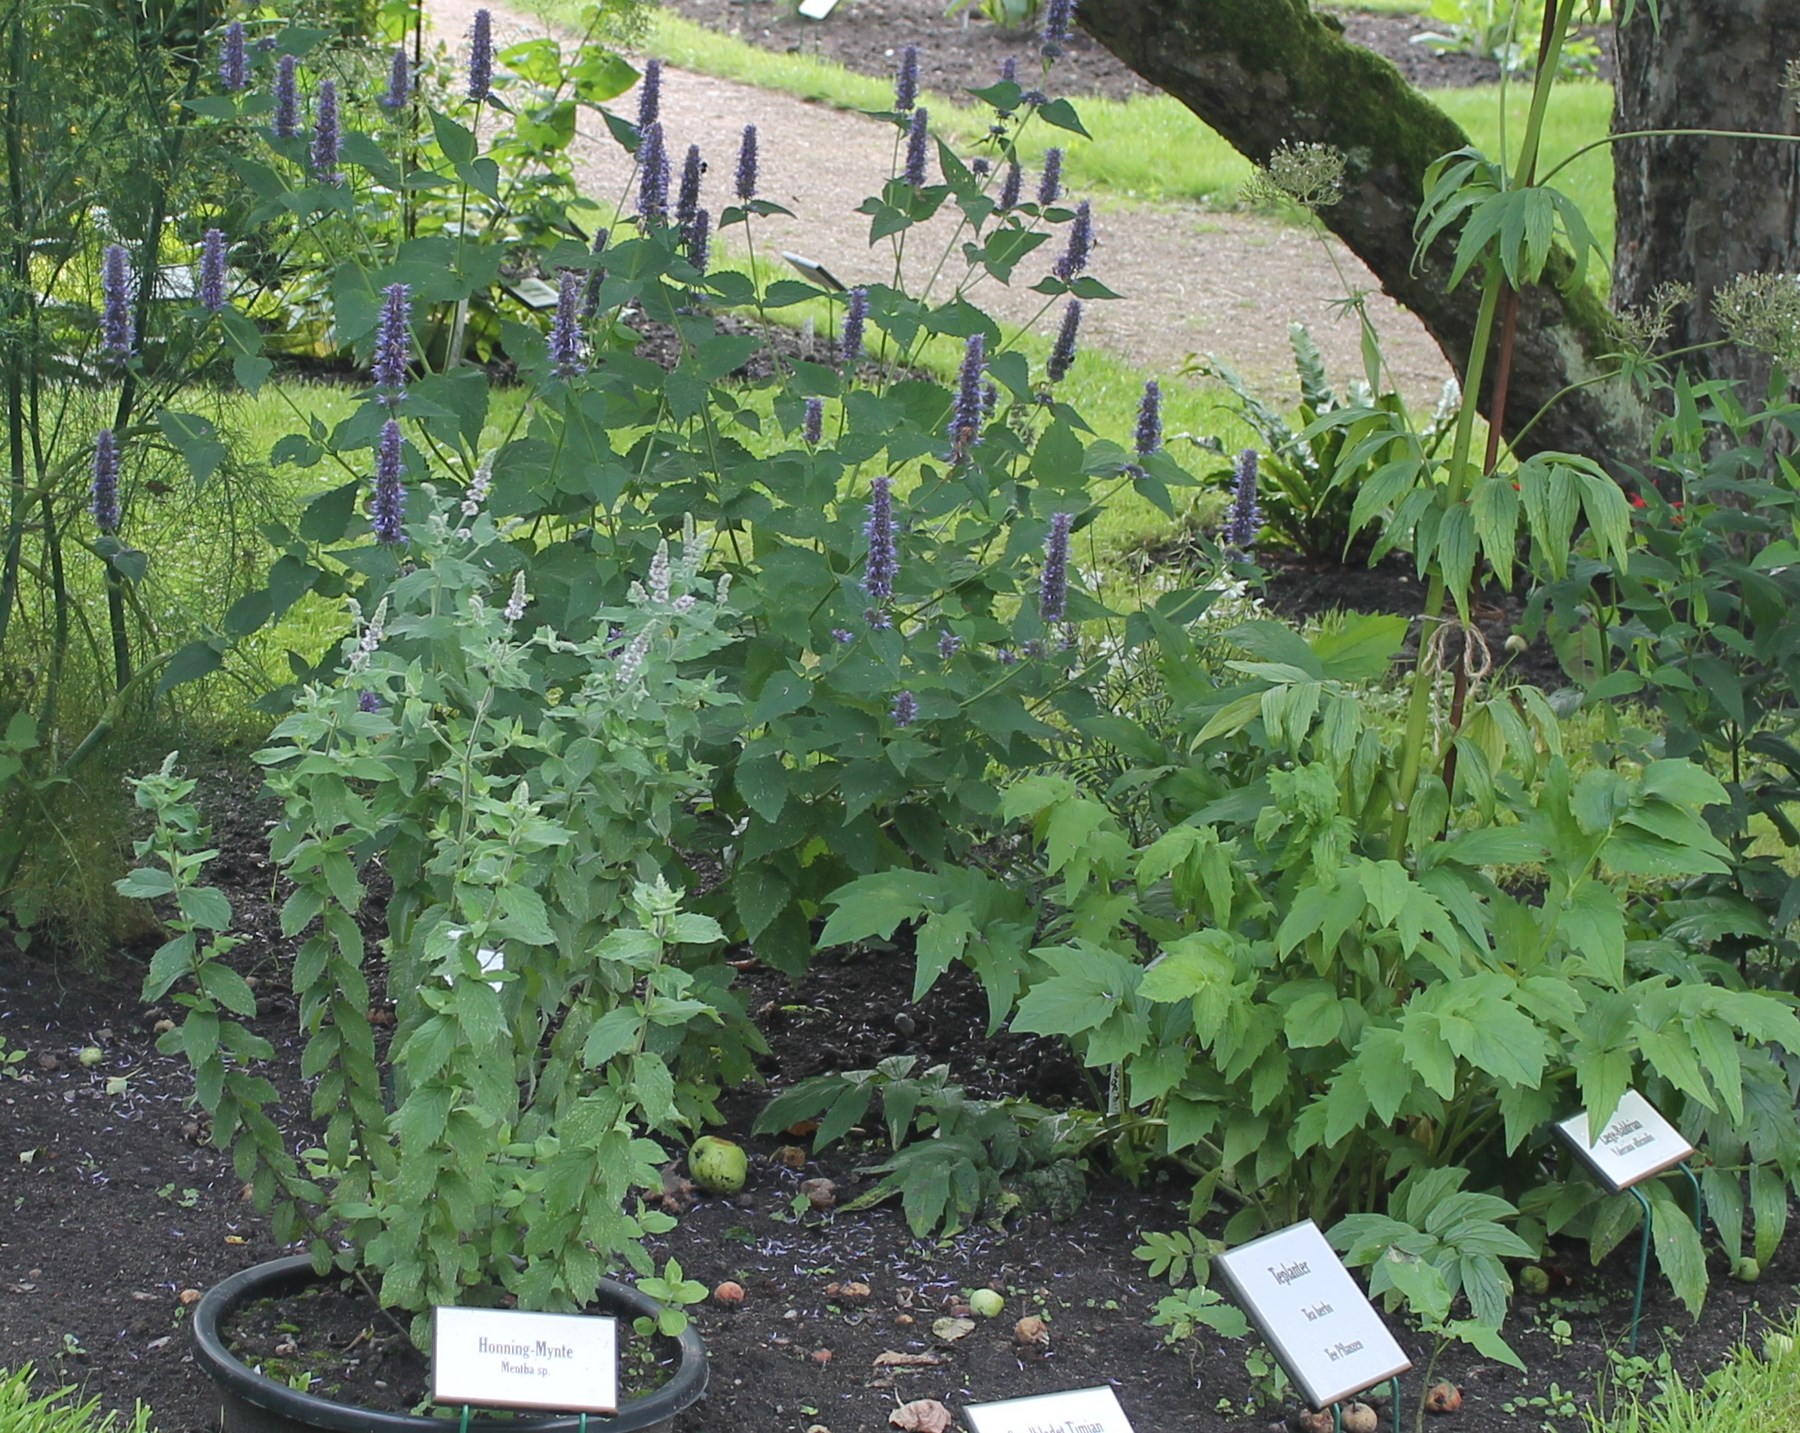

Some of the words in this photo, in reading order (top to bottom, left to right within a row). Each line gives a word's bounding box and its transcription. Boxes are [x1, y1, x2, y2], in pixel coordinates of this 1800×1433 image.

[1267, 1261, 1311, 1286] Teplanter
[1301, 1308, 1317, 1322] Tea
[1311, 1301, 1334, 1317] herbs
[479, 1336, 573, 1360] Honning-Mynte
[1323, 1348, 1340, 1362] Tee
[501, 1360, 534, 1375] Mentha
[537, 1367, 551, 1378] sp.
[1065, 1420, 1104, 1433] Timian
